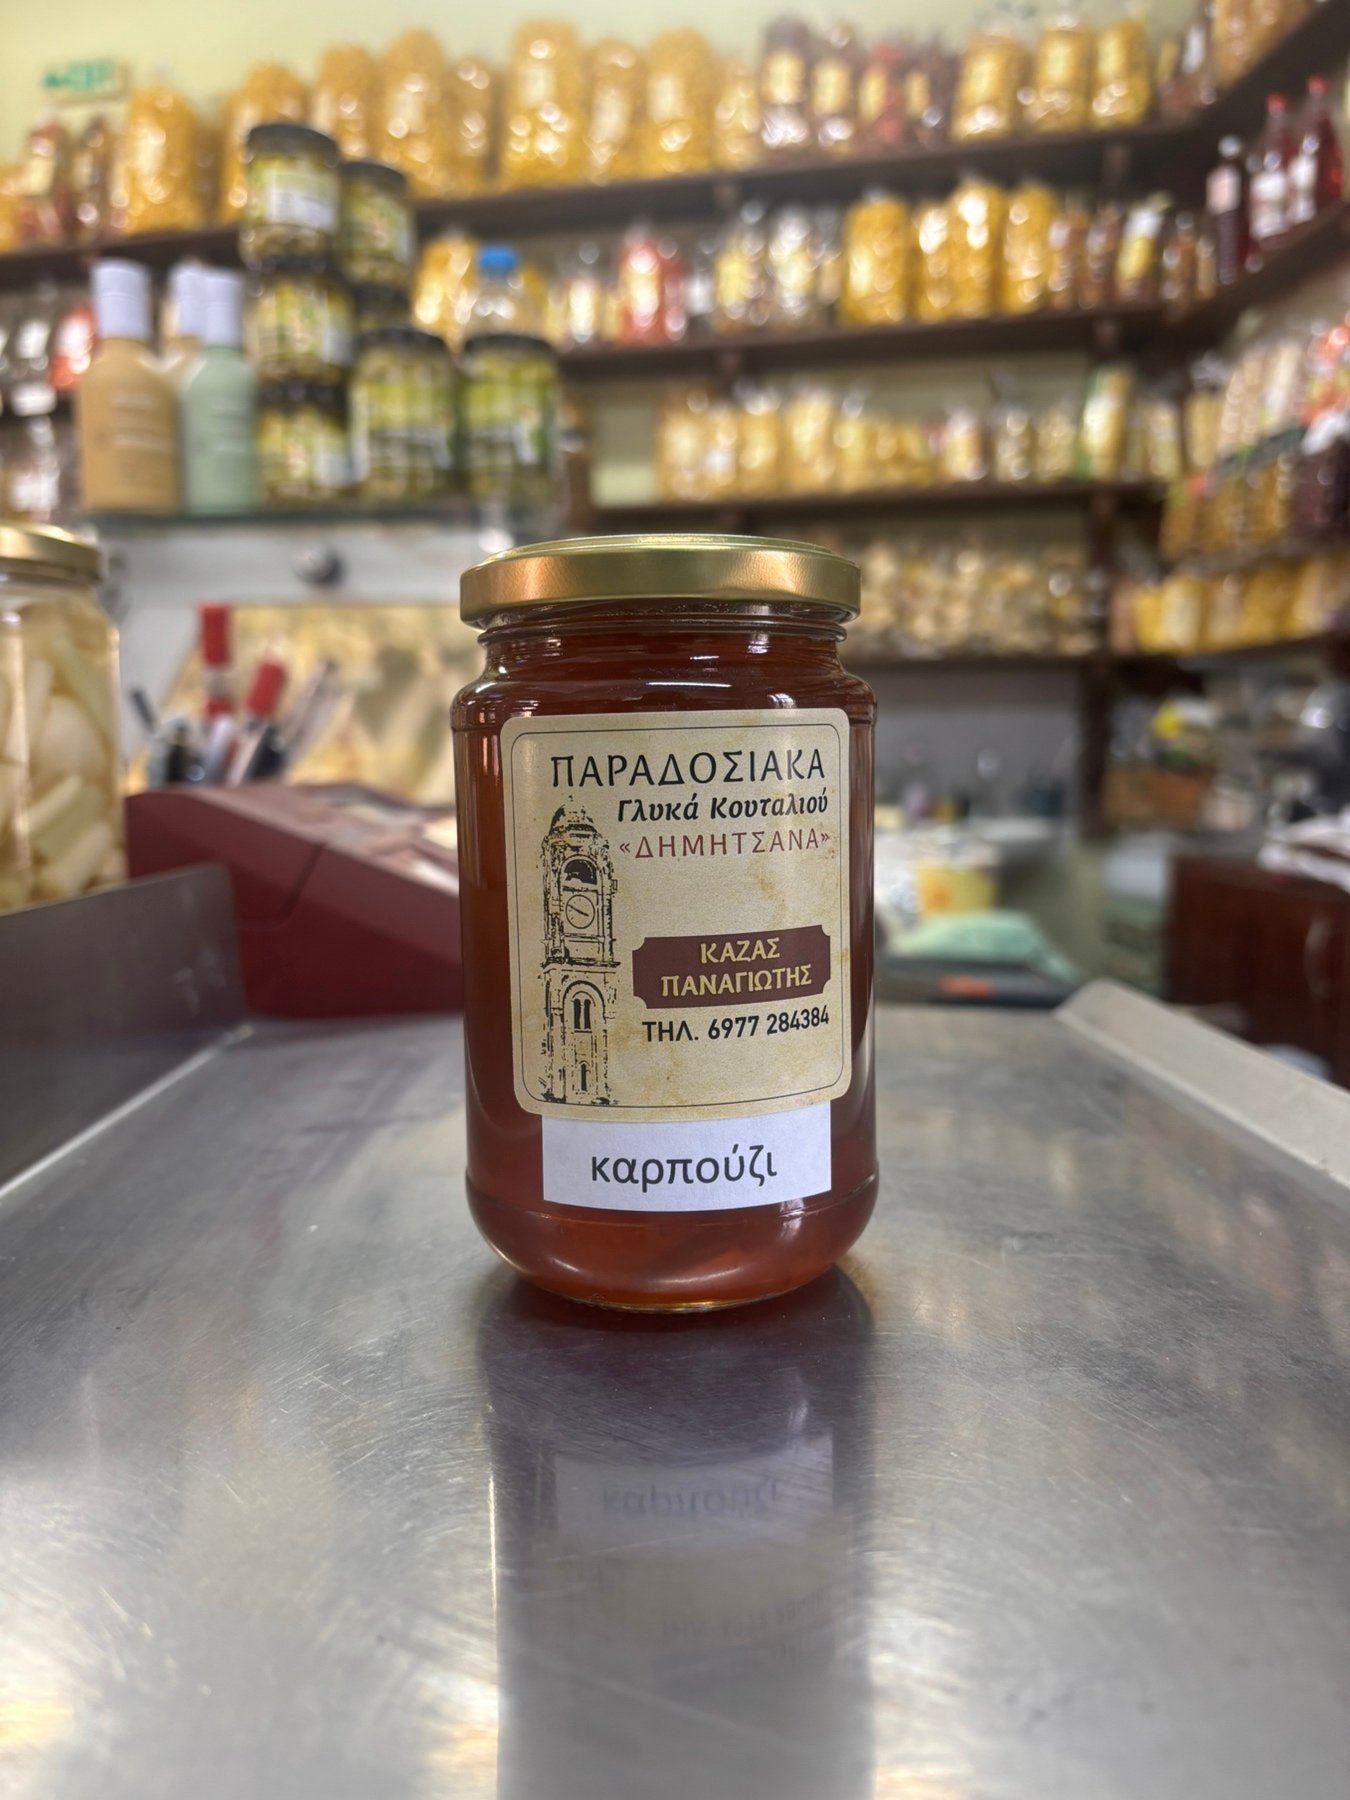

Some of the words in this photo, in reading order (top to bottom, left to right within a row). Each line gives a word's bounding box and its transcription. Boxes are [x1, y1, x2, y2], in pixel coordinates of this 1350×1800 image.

[551, 749, 825, 787] ΠΑΡΑΔΟΣΙΑΚΑ
[618, 793, 699, 821] Γλυκά
[711, 787, 828, 819] Κουταλιού
[619, 828, 830, 858] «ΔΗΜΗΤΣΑΝΑ»
[701, 937, 780, 964] ΚΑΖΑΣ
[661, 964, 812, 997] ΠΑΝΑΓΙΩΤΗΣ
[642, 1021, 699, 1042] ΤΗΛ.
[708, 1016, 759, 1039] 6977
[766, 1005, 829, 1035] 284384
[591, 1144, 777, 1193] καρπούζι
